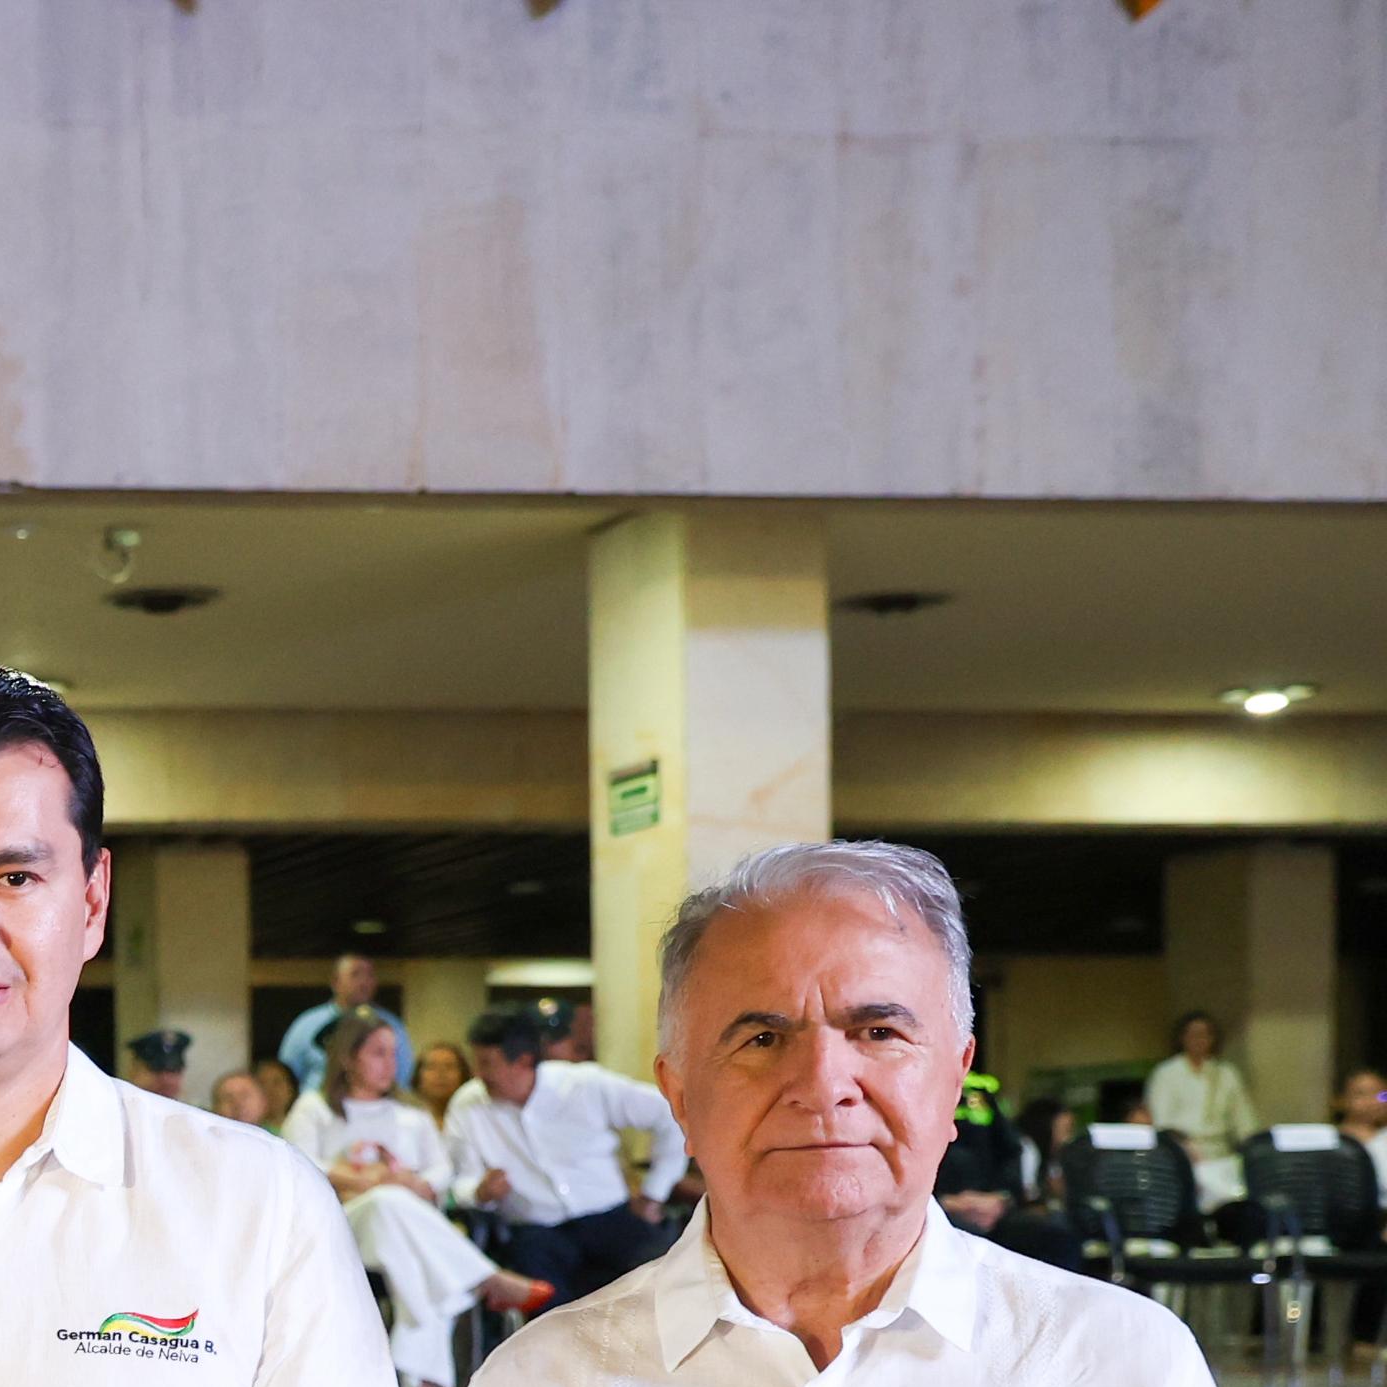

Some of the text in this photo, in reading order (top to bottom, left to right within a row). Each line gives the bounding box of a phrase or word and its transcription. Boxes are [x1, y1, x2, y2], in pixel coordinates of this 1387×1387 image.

[56, 1329, 122, 1342] German
[128, 1331, 200, 1350] Casagua
[75, 1341, 199, 1364] Alcalde de Neiva
